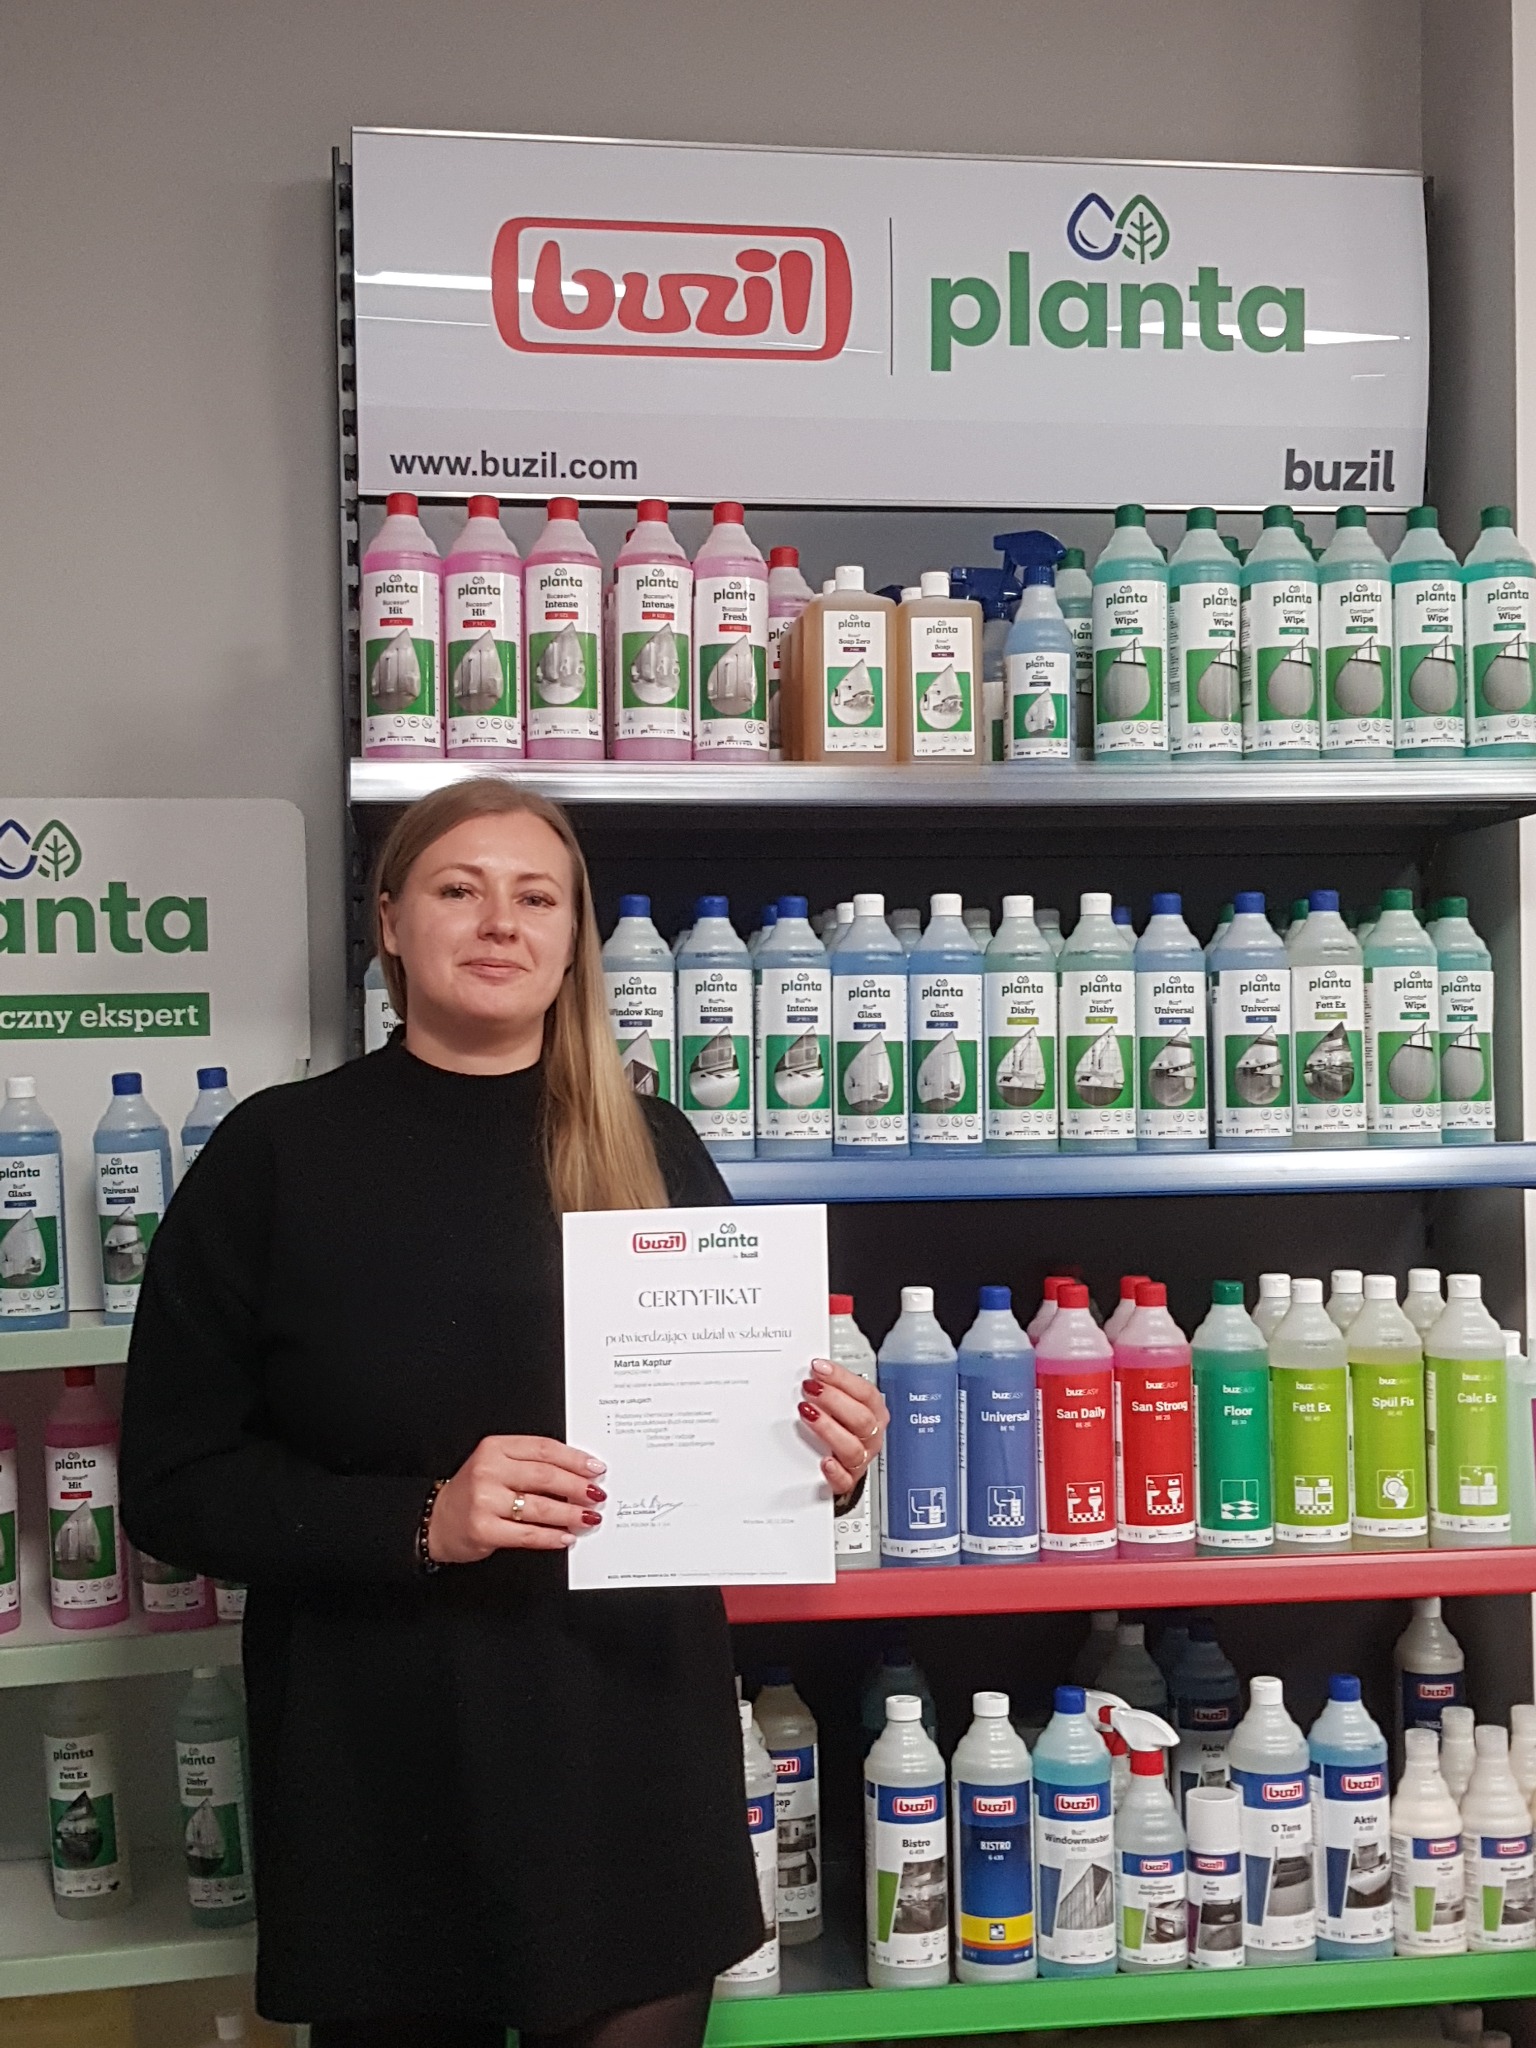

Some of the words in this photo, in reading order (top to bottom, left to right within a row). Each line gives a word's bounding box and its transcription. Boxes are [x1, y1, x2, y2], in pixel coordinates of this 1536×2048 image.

[532, 239, 813, 335] buzil
[930, 251, 1305, 371] planta
[390, 449, 638, 482] www.buzil.com
[1284, 448, 1394, 492] buzil
[540, 576, 582, 590] planta
[636, 577, 678, 590] planta
[375, 583, 418, 596] planta
[458, 586, 500, 598] planta
[714, 590, 755, 602] planta
[1106, 594, 1148, 608] planta
[1203, 595, 1237, 608] planta
[1273, 593, 1312, 605] planta
[1340, 592, 1382, 605] planta
[1416, 591, 1456, 604] planta
[1488, 590, 1529, 603] planta
[642, 601, 674, 609] Intense
[723, 613, 747, 621] Fresh
[1115, 617, 1137, 625] Wipe
[1351, 615, 1373, 623] Wipe
[1428, 614, 1449, 622] Wipe
[1499, 612, 1521, 620] Wipe
[838, 619, 870, 629] planta
[1214, 619, 1233, 627] Wipe
[927, 626, 958, 635] planta
[1026, 661, 1054, 670] planta
[695, 981, 737, 994] planta
[781, 981, 822, 993] planta
[1002, 984, 1043, 996] planta
[1080, 982, 1122, 995] planta
[1154, 983, 1194, 996] planta
[1240, 981, 1280, 994] planta
[1309, 978, 1351, 990] planta
[1394, 979, 1432, 991] planta
[1441, 983, 1481, 995] planta
[614, 985, 656, 997] planta
[849, 988, 890, 1000] planta
[922, 987, 963, 999] planta
[645, 1008, 663, 1017] King
[1011, 1007, 1035, 1015] Dishy
[1089, 1005, 1114, 1014] Dishy
[1452, 1004, 1473, 1012] Wipe
[80, 1003, 199, 1032] ekspert
[858, 1011, 881, 1019] Glass
[101, 1164, 138, 1176] planta
[8, 1190, 32, 1198] Glass
[103, 1186, 139, 1194] Universal
[639, 1236, 680, 1249] buzil
[699, 1234, 758, 1251] planta
[638, 1288, 761, 1307] CERTYFIKAT
[614, 1360, 640, 1368] Marta
[643, 1359, 671, 1367] Kaptur
[1372, 1397, 1398, 1408] Spül
[1401, 1397, 1414, 1406] Fix
[1458, 1394, 1481, 1403] Calc
[1485, 1394, 1496, 1403] Ex
[1132, 1402, 1152, 1411] San
[1156, 1401, 1187, 1411] Strong
[1224, 1406, 1253, 1416] Floor
[1293, 1403, 1315, 1412] Fett
[1318, 1402, 1331, 1412] Ex
[910, 1413, 940, 1424] Glass
[981, 1410, 1030, 1422] Universal
[1057, 1409, 1077, 1419] San
[1081, 1407, 1105, 1419] Daily
[55, 1459, 96, 1471] planta
[1423, 1686, 1451, 1696] buzil
[1197, 1710, 1226, 1720] buzil
[53, 1749, 93, 1761] planta
[180, 1755, 215, 1766] planta
[1348, 1778, 1379, 1789] buzil
[1270, 1786, 1300, 1798] buzil
[899, 1799, 934, 1812] buzil
[977, 1802, 1011, 1812] buzil
[1061, 1798, 1094, 1810] buzil
[1354, 1816, 1377, 1824] Aktiv
[902, 1839, 930, 1848] Bistro
[1045, 1833, 1109, 1844] Windowmaster
[981, 1841, 1011, 1850] BISTRO
